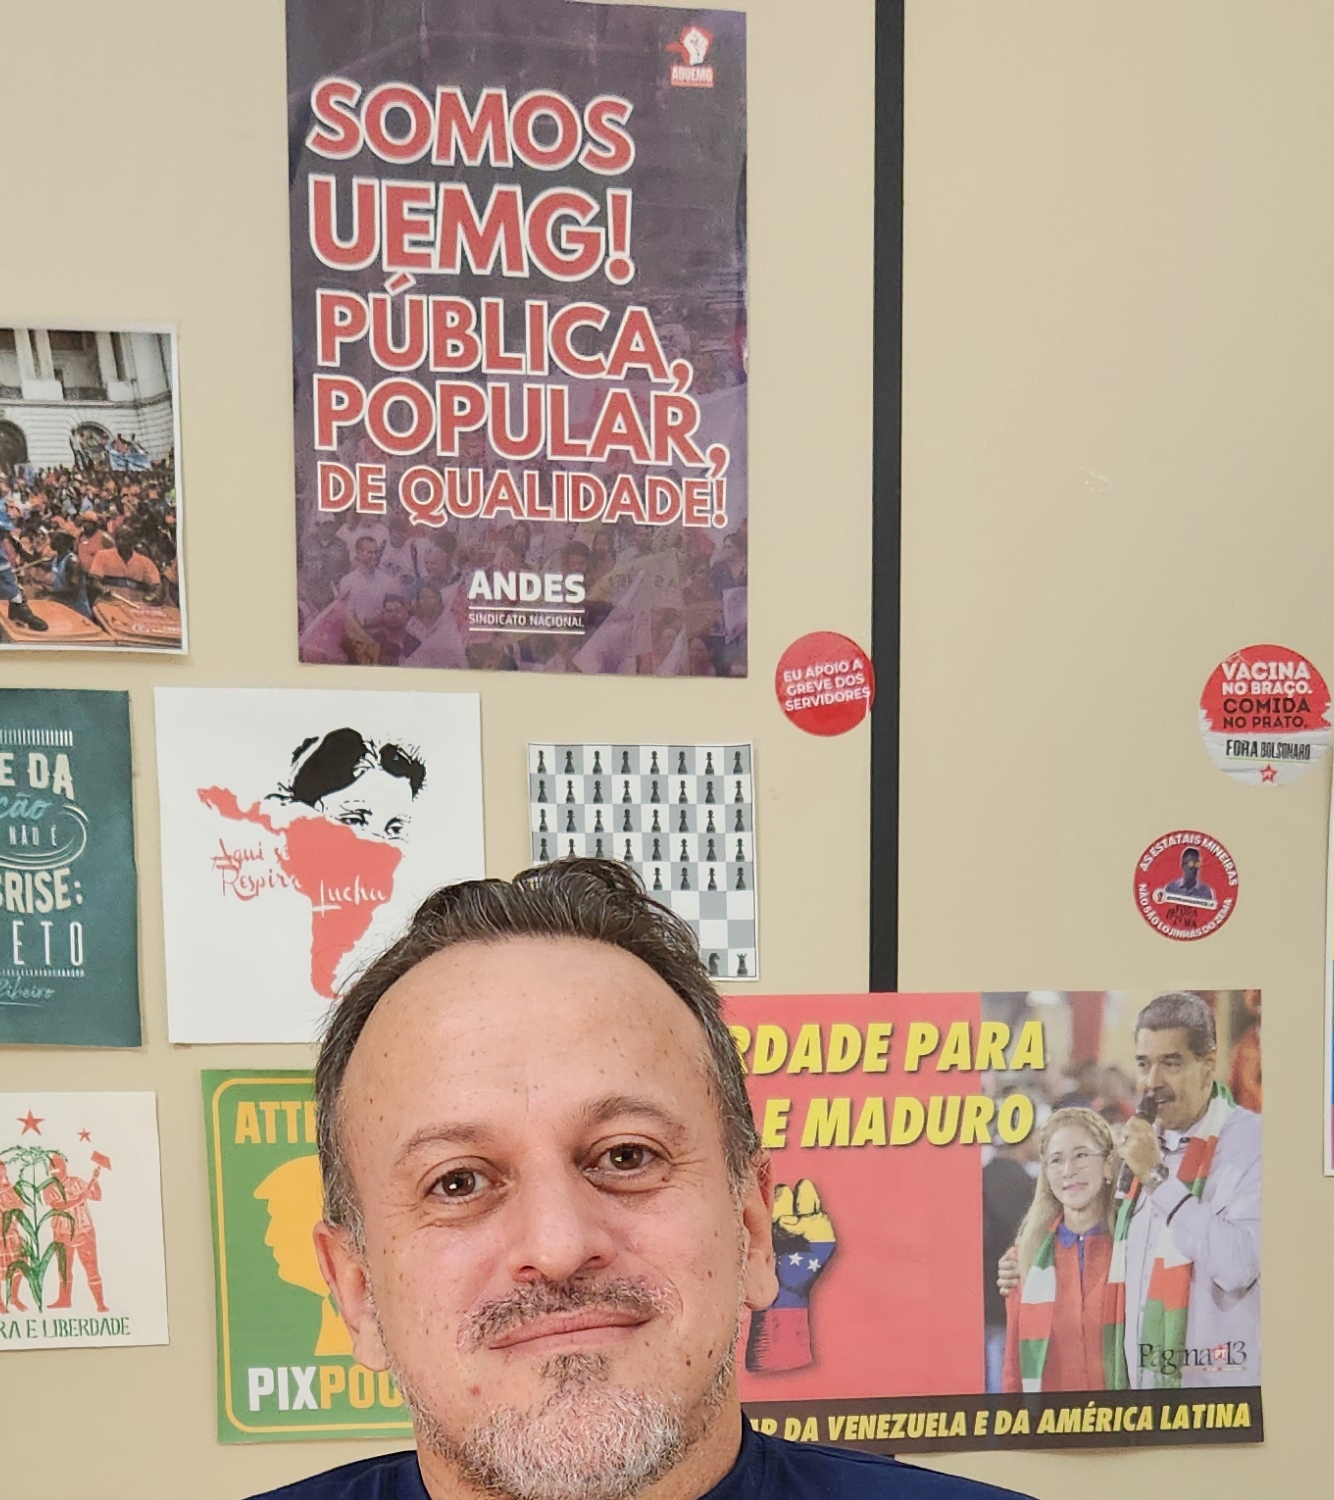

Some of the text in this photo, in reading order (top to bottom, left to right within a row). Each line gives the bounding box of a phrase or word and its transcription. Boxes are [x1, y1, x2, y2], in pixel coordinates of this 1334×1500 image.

[305, 76, 635, 175] SOMOS
[308, 173, 635, 285] UEMG!
[315, 271, 694, 391] PÚBLICA,
[313, 374, 730, 480] POPULAR,
[316, 462, 728, 529] DE QUALIDADE!
[468, 570, 585, 603] ANDES
[469, 612, 585, 628] SINDICATO NACIONAL
[783, 658, 864, 682] EU APOIO A
[786, 673, 865, 696] GREVE DOS
[1221, 661, 1311, 681] VACINA
[785, 686, 871, 712] SERVIDORES
[1222, 680, 1313, 698] NO BRAÇO.
[1223, 698, 1311, 714] COMIDA
[1223, 715, 1308, 729] NO PRATO.
[1225, 739, 1311, 761] FORA BOLSONARO
[27, 752, 75, 800] DA
[9, 824, 40, 846] NÃO
[50, 823, 58, 846] É
[210, 838, 265, 871] Aqui
[1139, 833, 1238, 886] AS ESTATAIS MINEIRAS
[212, 864, 302, 901] Respira
[904, 1020, 1046, 1073] PARA
[761, 1093, 1033, 1149] E MADURO
[26, 1319, 38, 1339] E
[43, 1317, 131, 1338] LIBERDADE
[1138, 1340, 1247, 1375] Págna 13
[784, 1416, 819, 1442] DA
[828, 1411, 966, 1442] VENEZUELA
[973, 1410, 989, 1436] E
[993, 1409, 1030, 1435] DA
[1036, 1400, 1152, 1434] AMÉRICA
[1159, 1402, 1251, 1430] LATINA
